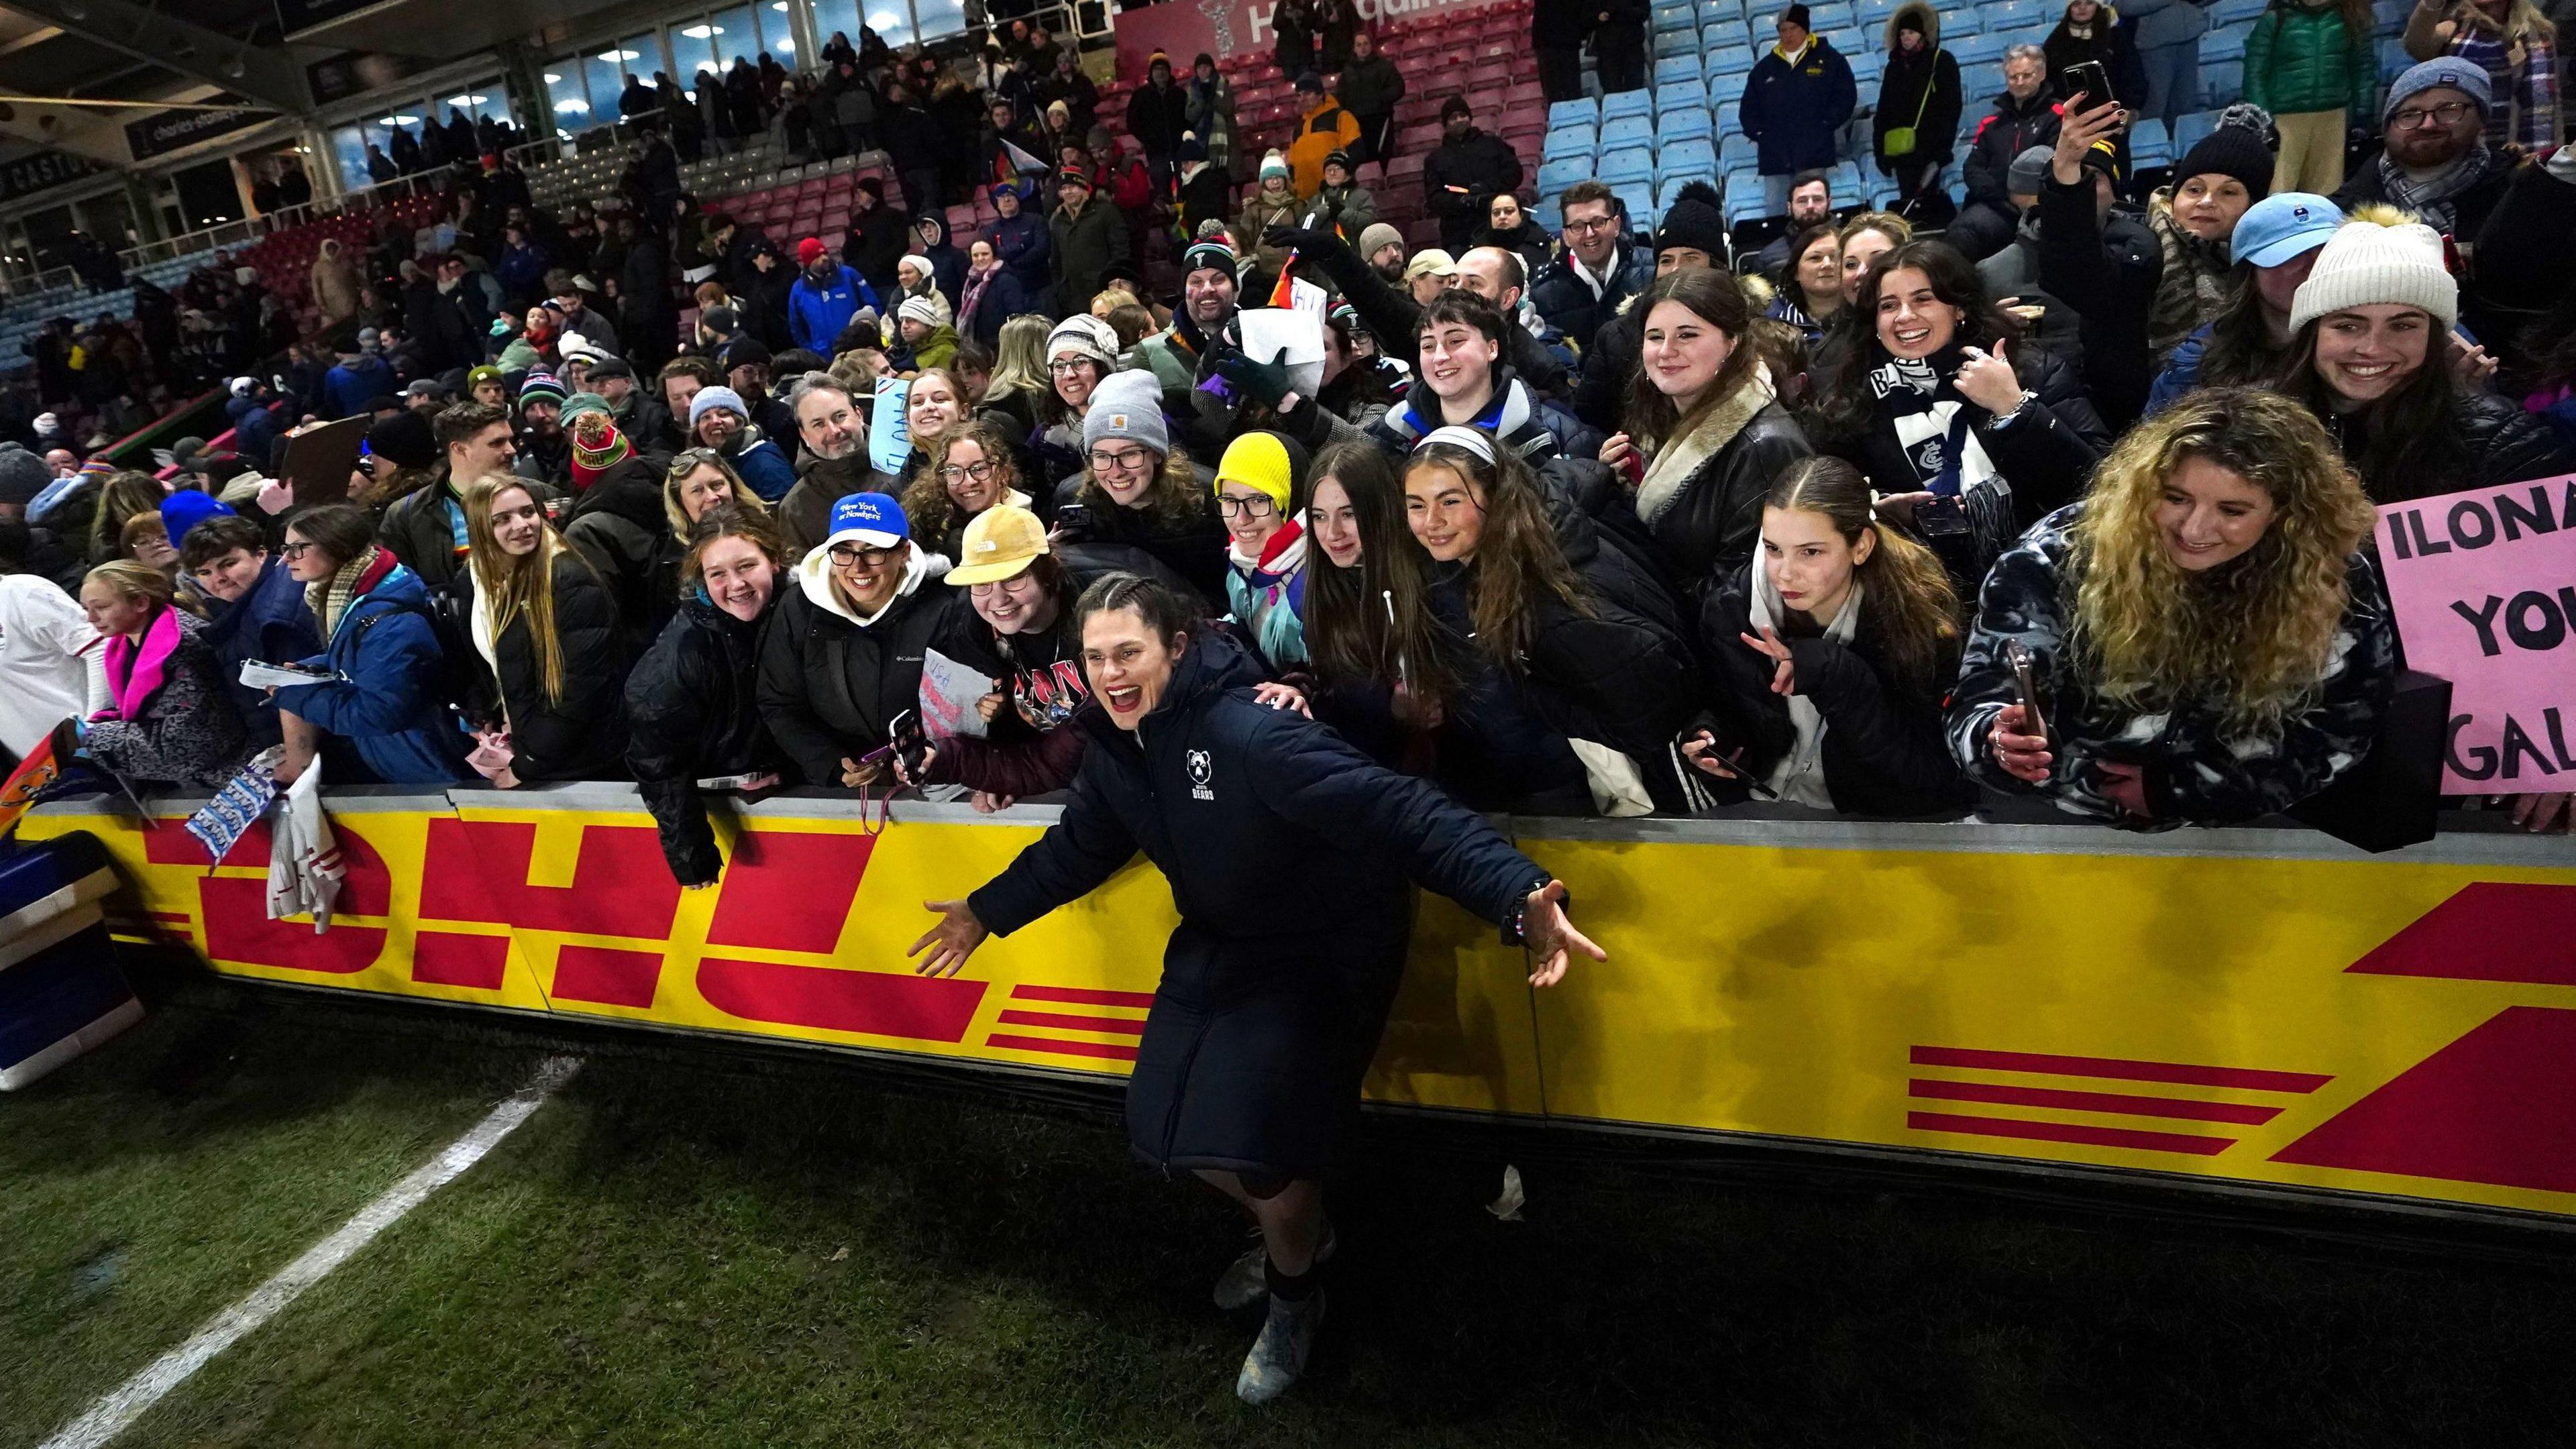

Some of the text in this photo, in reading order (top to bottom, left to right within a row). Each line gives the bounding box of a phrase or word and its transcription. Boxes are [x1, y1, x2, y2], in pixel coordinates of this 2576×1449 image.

[840, 501, 881, 515] New York
[845, 509, 881, 521] Nowhere
[1191, 788, 1214, 801] BEARS
[143, 816, 990, 1044] DHL
